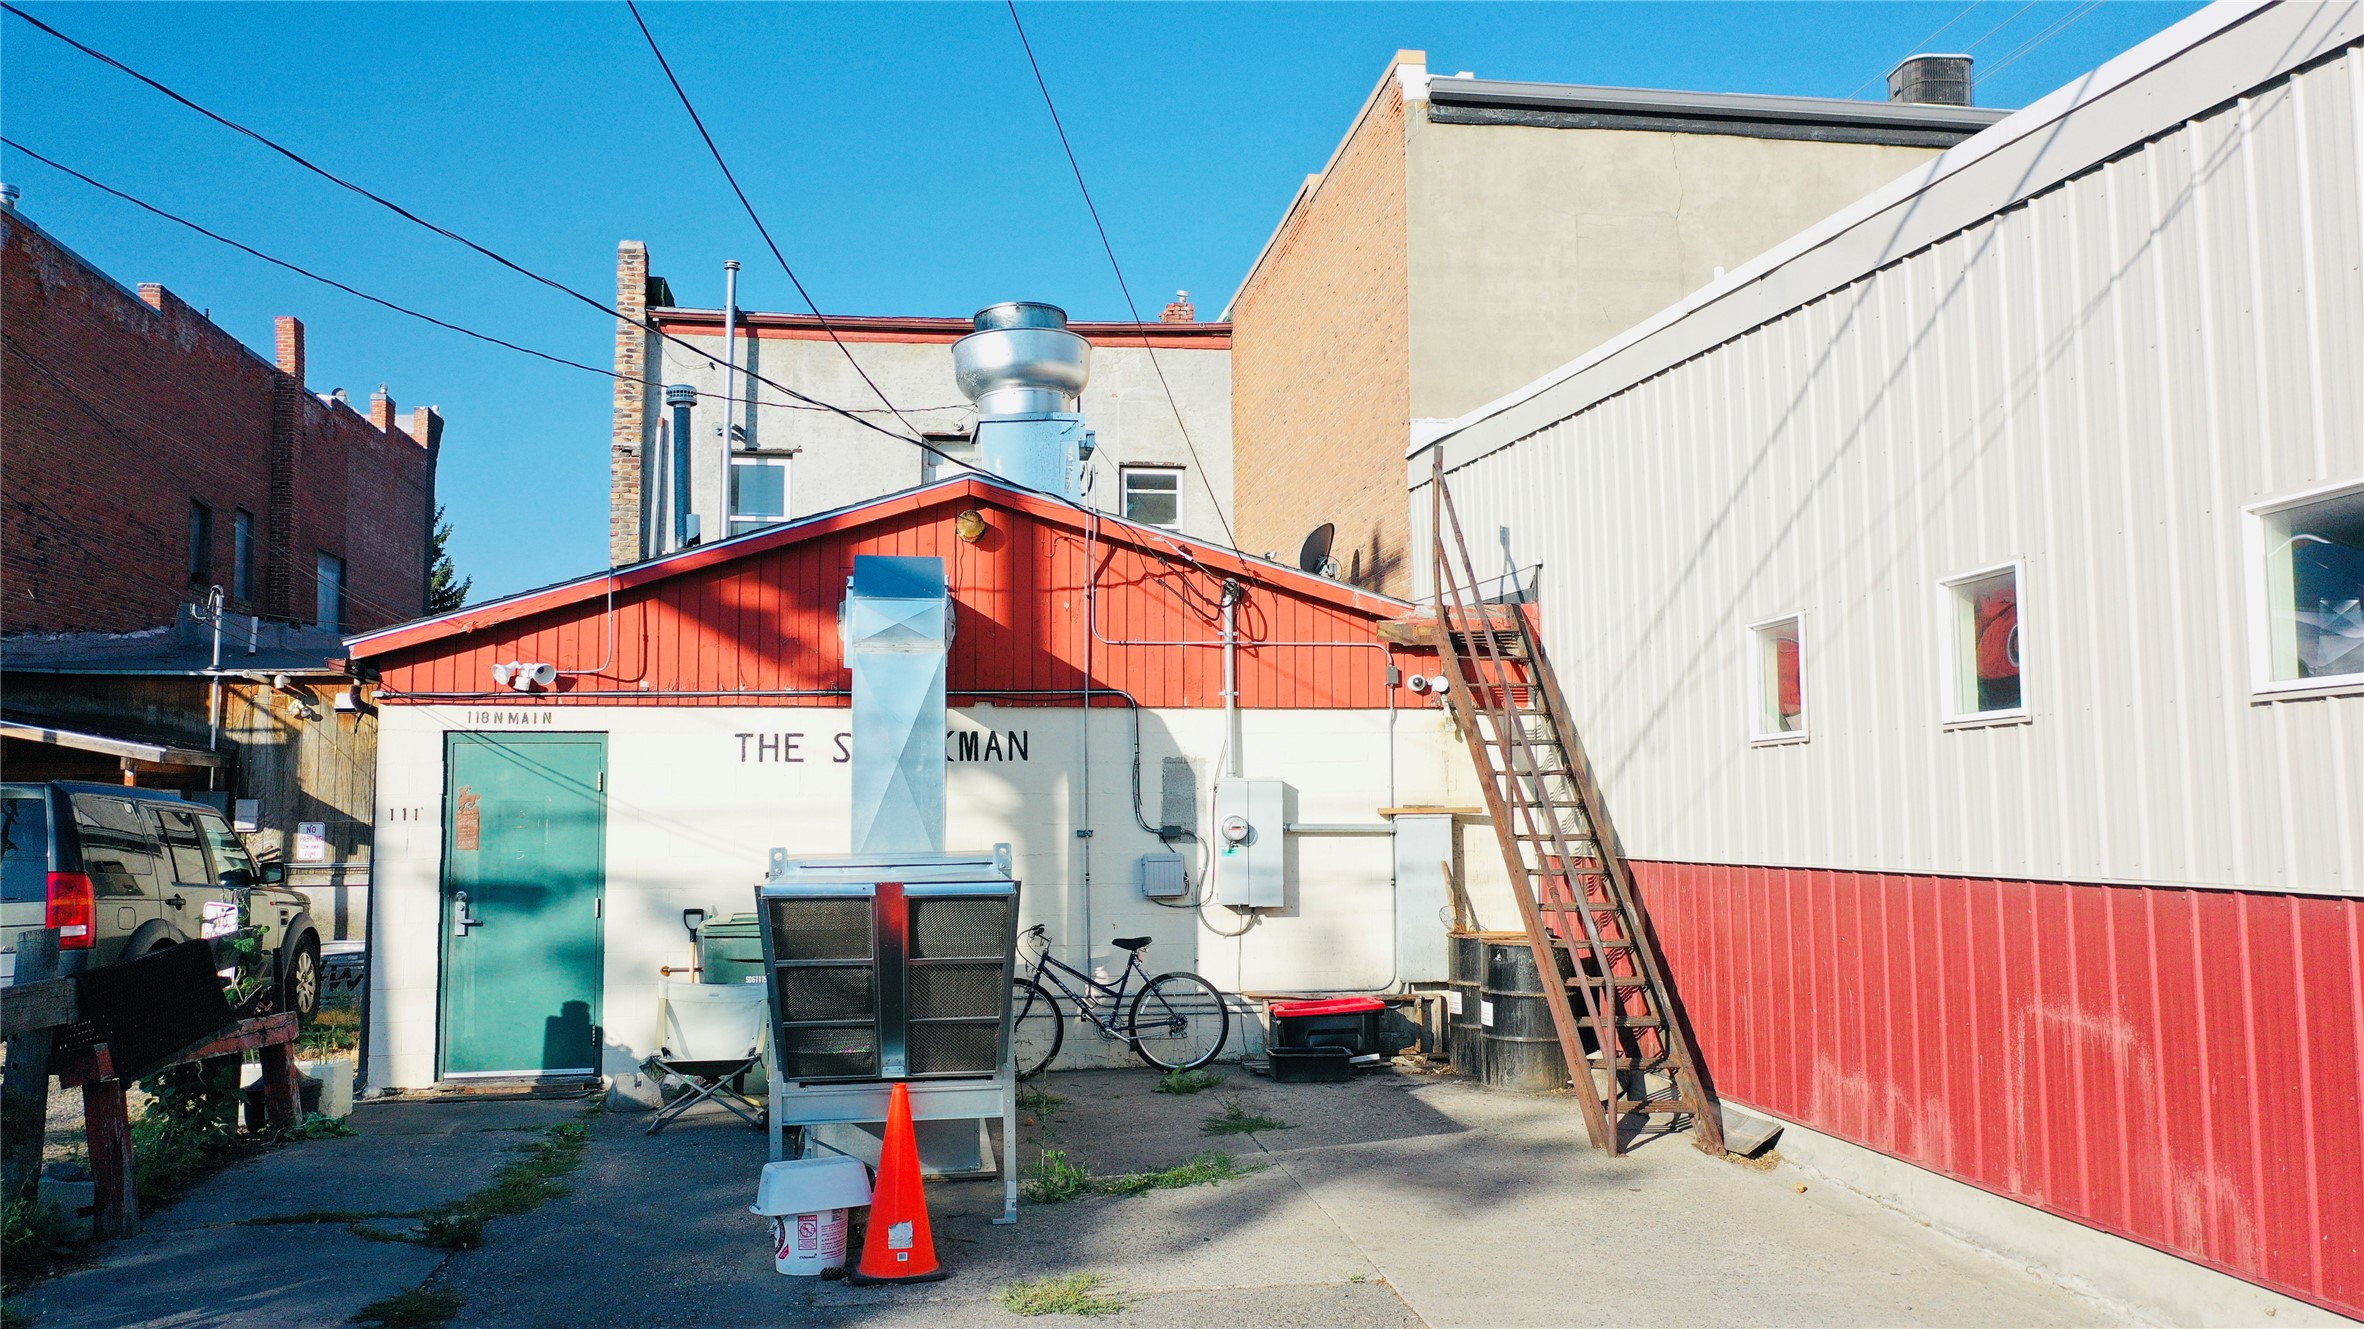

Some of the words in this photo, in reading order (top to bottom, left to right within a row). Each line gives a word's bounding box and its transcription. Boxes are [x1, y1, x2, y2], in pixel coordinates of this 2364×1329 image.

[468, 711, 489, 724] 118
[494, 711, 503, 724] N
[508, 711, 552, 724] MAIN
[734, 732, 804, 763] THE
[389, 807, 418, 821] 111
[306, 825, 317, 833] NO
